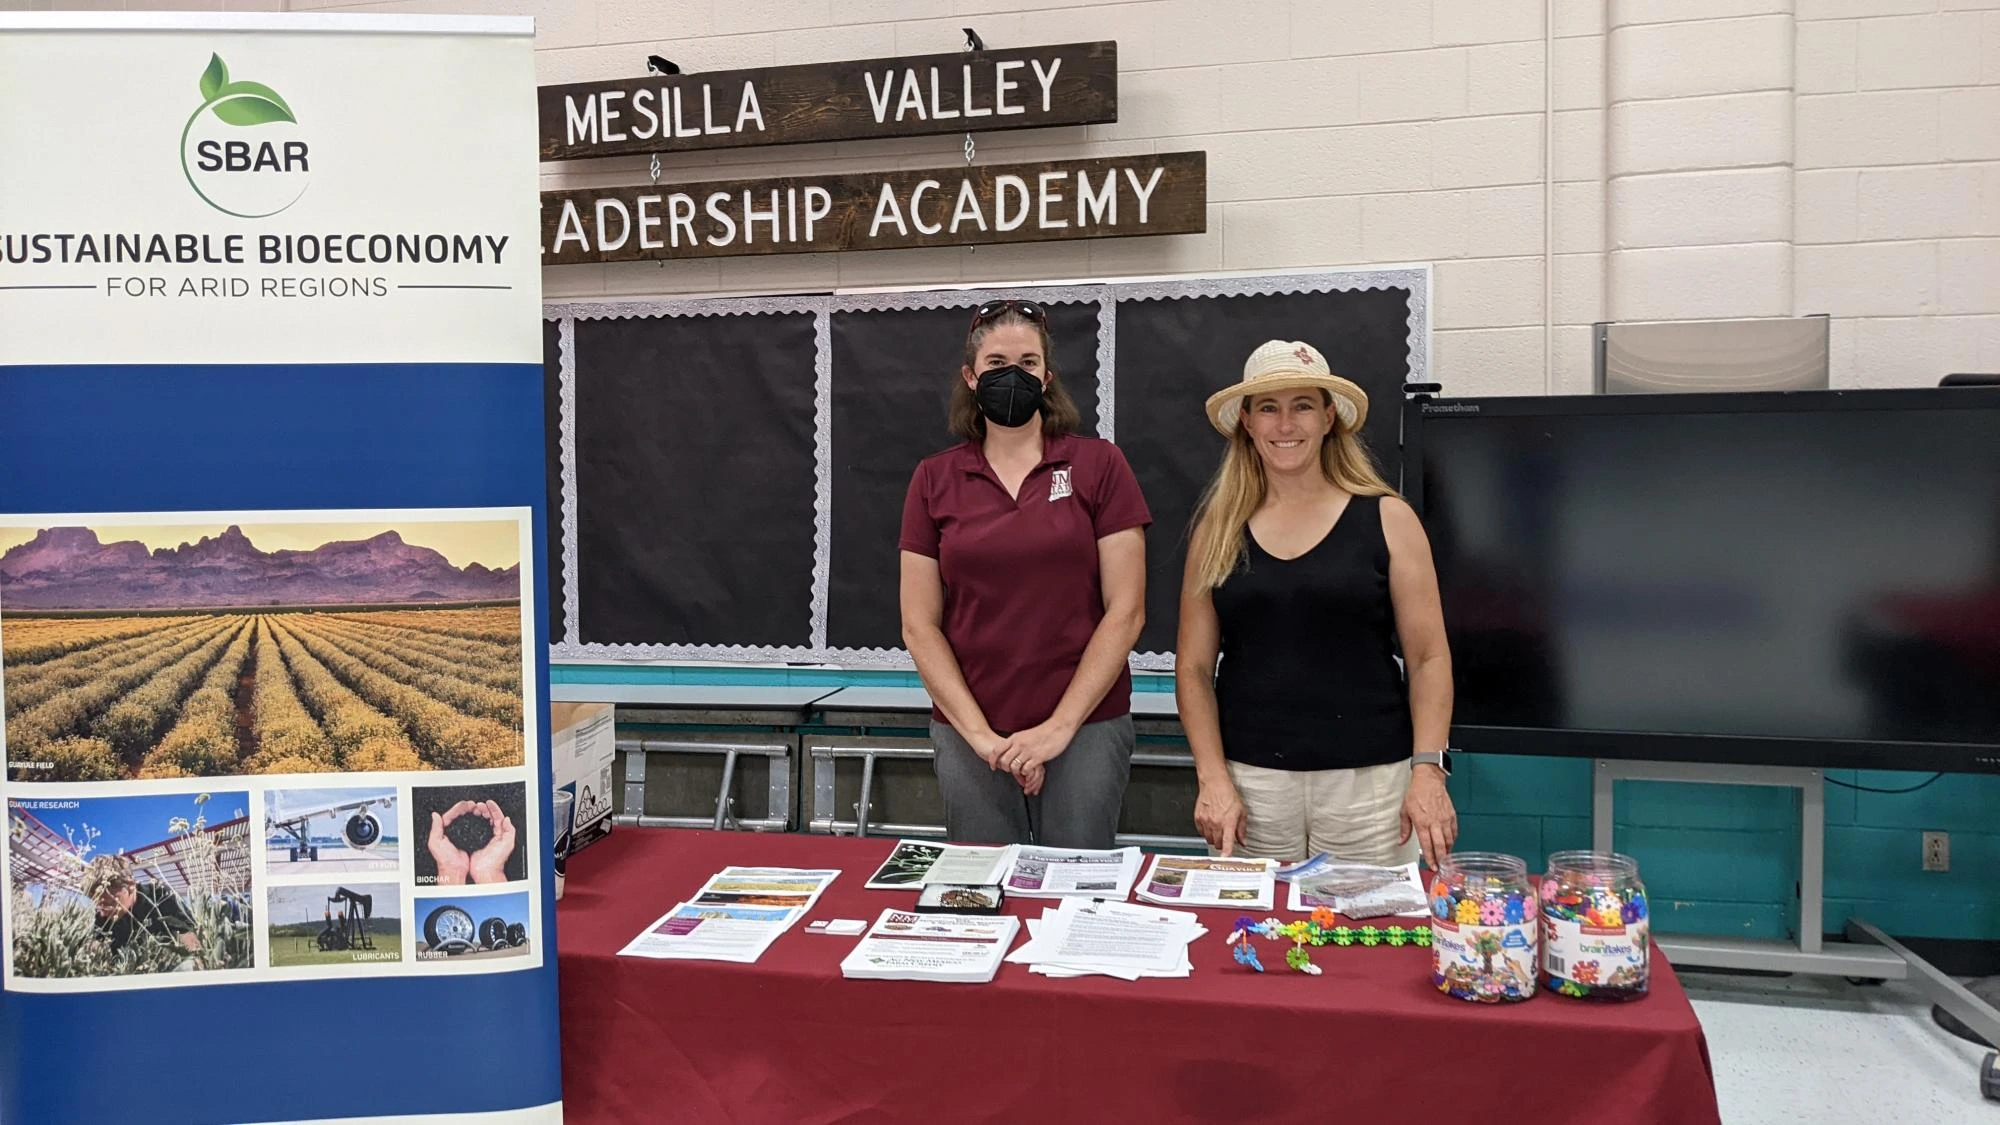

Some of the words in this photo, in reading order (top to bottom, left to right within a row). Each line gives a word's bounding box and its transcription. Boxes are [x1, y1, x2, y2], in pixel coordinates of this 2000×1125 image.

[565, 81, 765, 146] MESILLA
[863, 57, 1062, 122] VALLEY
[197, 140, 310, 173] SBAR
[868, 166, 1165, 237] ACADEMY
[0, 233, 244, 265] USTAINABLE
[259, 234, 509, 265] BIOECONOMY
[107, 277, 167, 298] FOR
[178, 277, 250, 298] ARID
[261, 277, 388, 299] REGIONS
[8, 761, 35, 769] GUAYULE
[8, 800, 38, 809] GUAYULE
[39, 801, 80, 809] RESEARCH
[416, 875, 450, 883] BIOCHAR
[1579, 942, 1632, 954] brainflakes
[352, 952, 400, 961] LUBRICANTS
[417, 951, 448, 959] RUBBER
